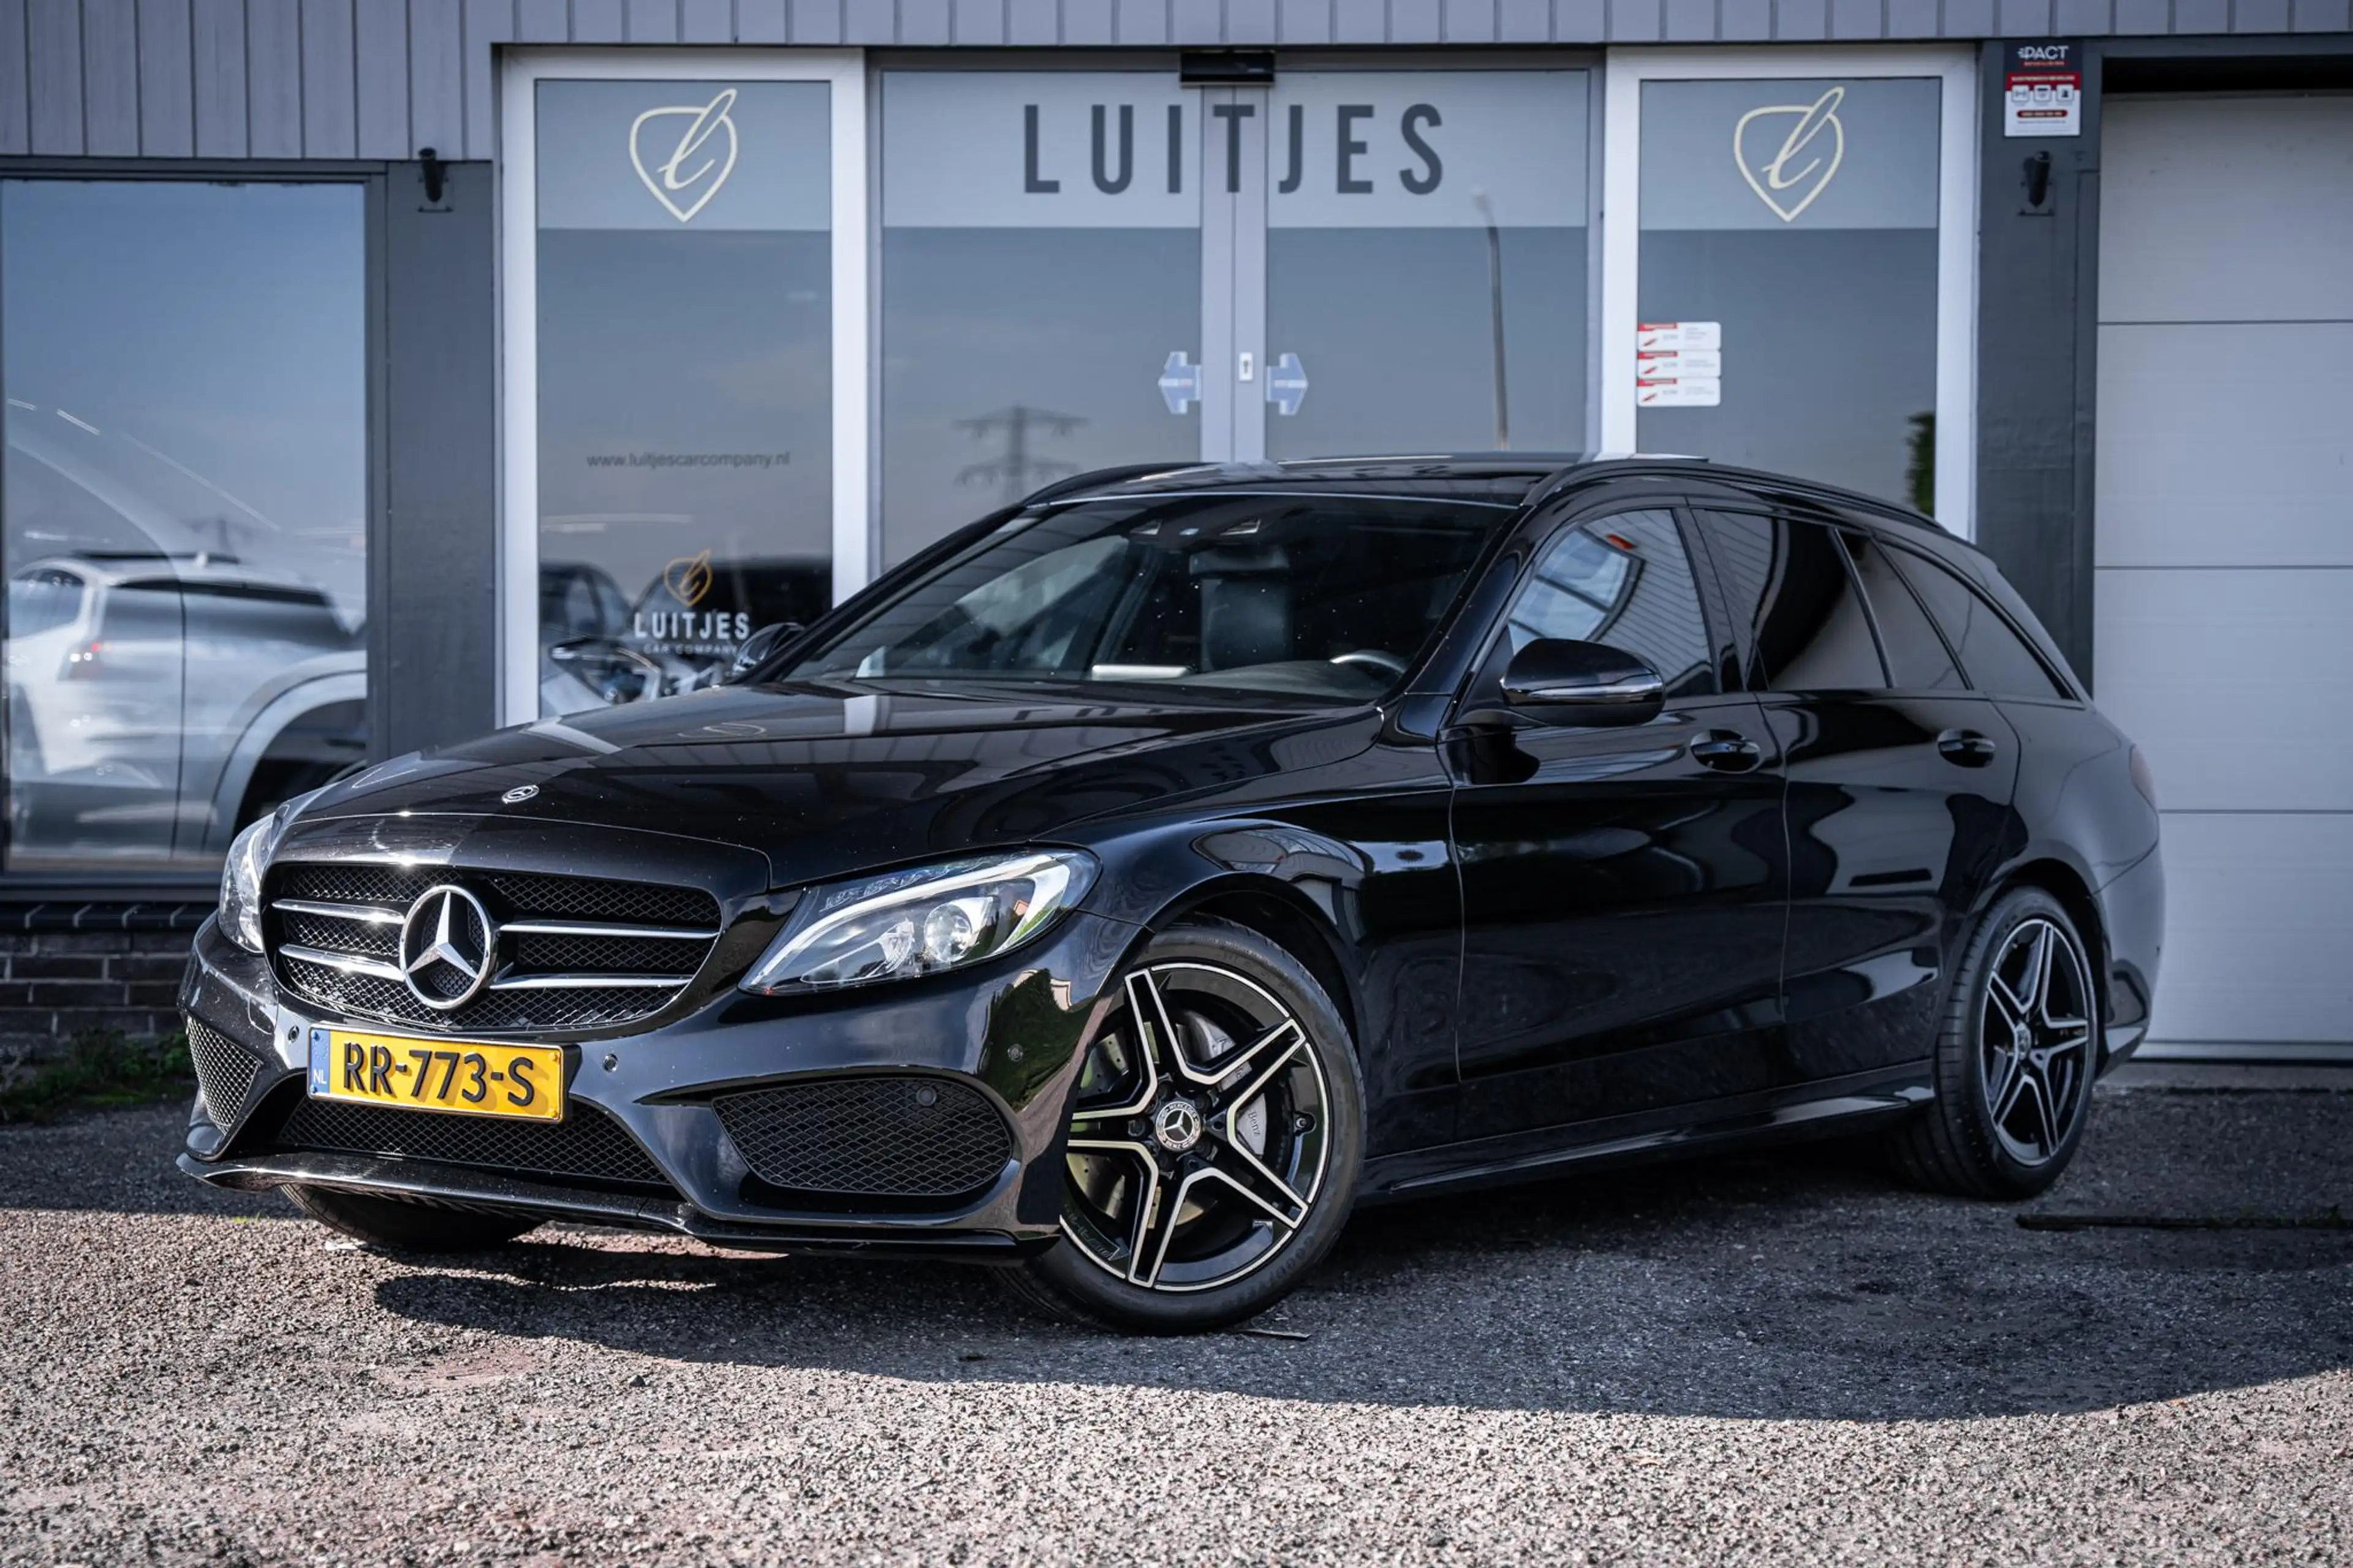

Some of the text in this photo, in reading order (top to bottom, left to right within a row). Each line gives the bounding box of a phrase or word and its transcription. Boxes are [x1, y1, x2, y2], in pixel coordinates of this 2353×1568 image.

[1024, 103, 1444, 195] LUITJES
[586, 452, 790, 469] www.luitjescarcompany.nl
[634, 612, 750, 640] LUITJES
[643, 643, 738, 654] CAR COMPANY
[313, 1068, 328, 1085] NL
[343, 1042, 534, 1107] RR-773-S
